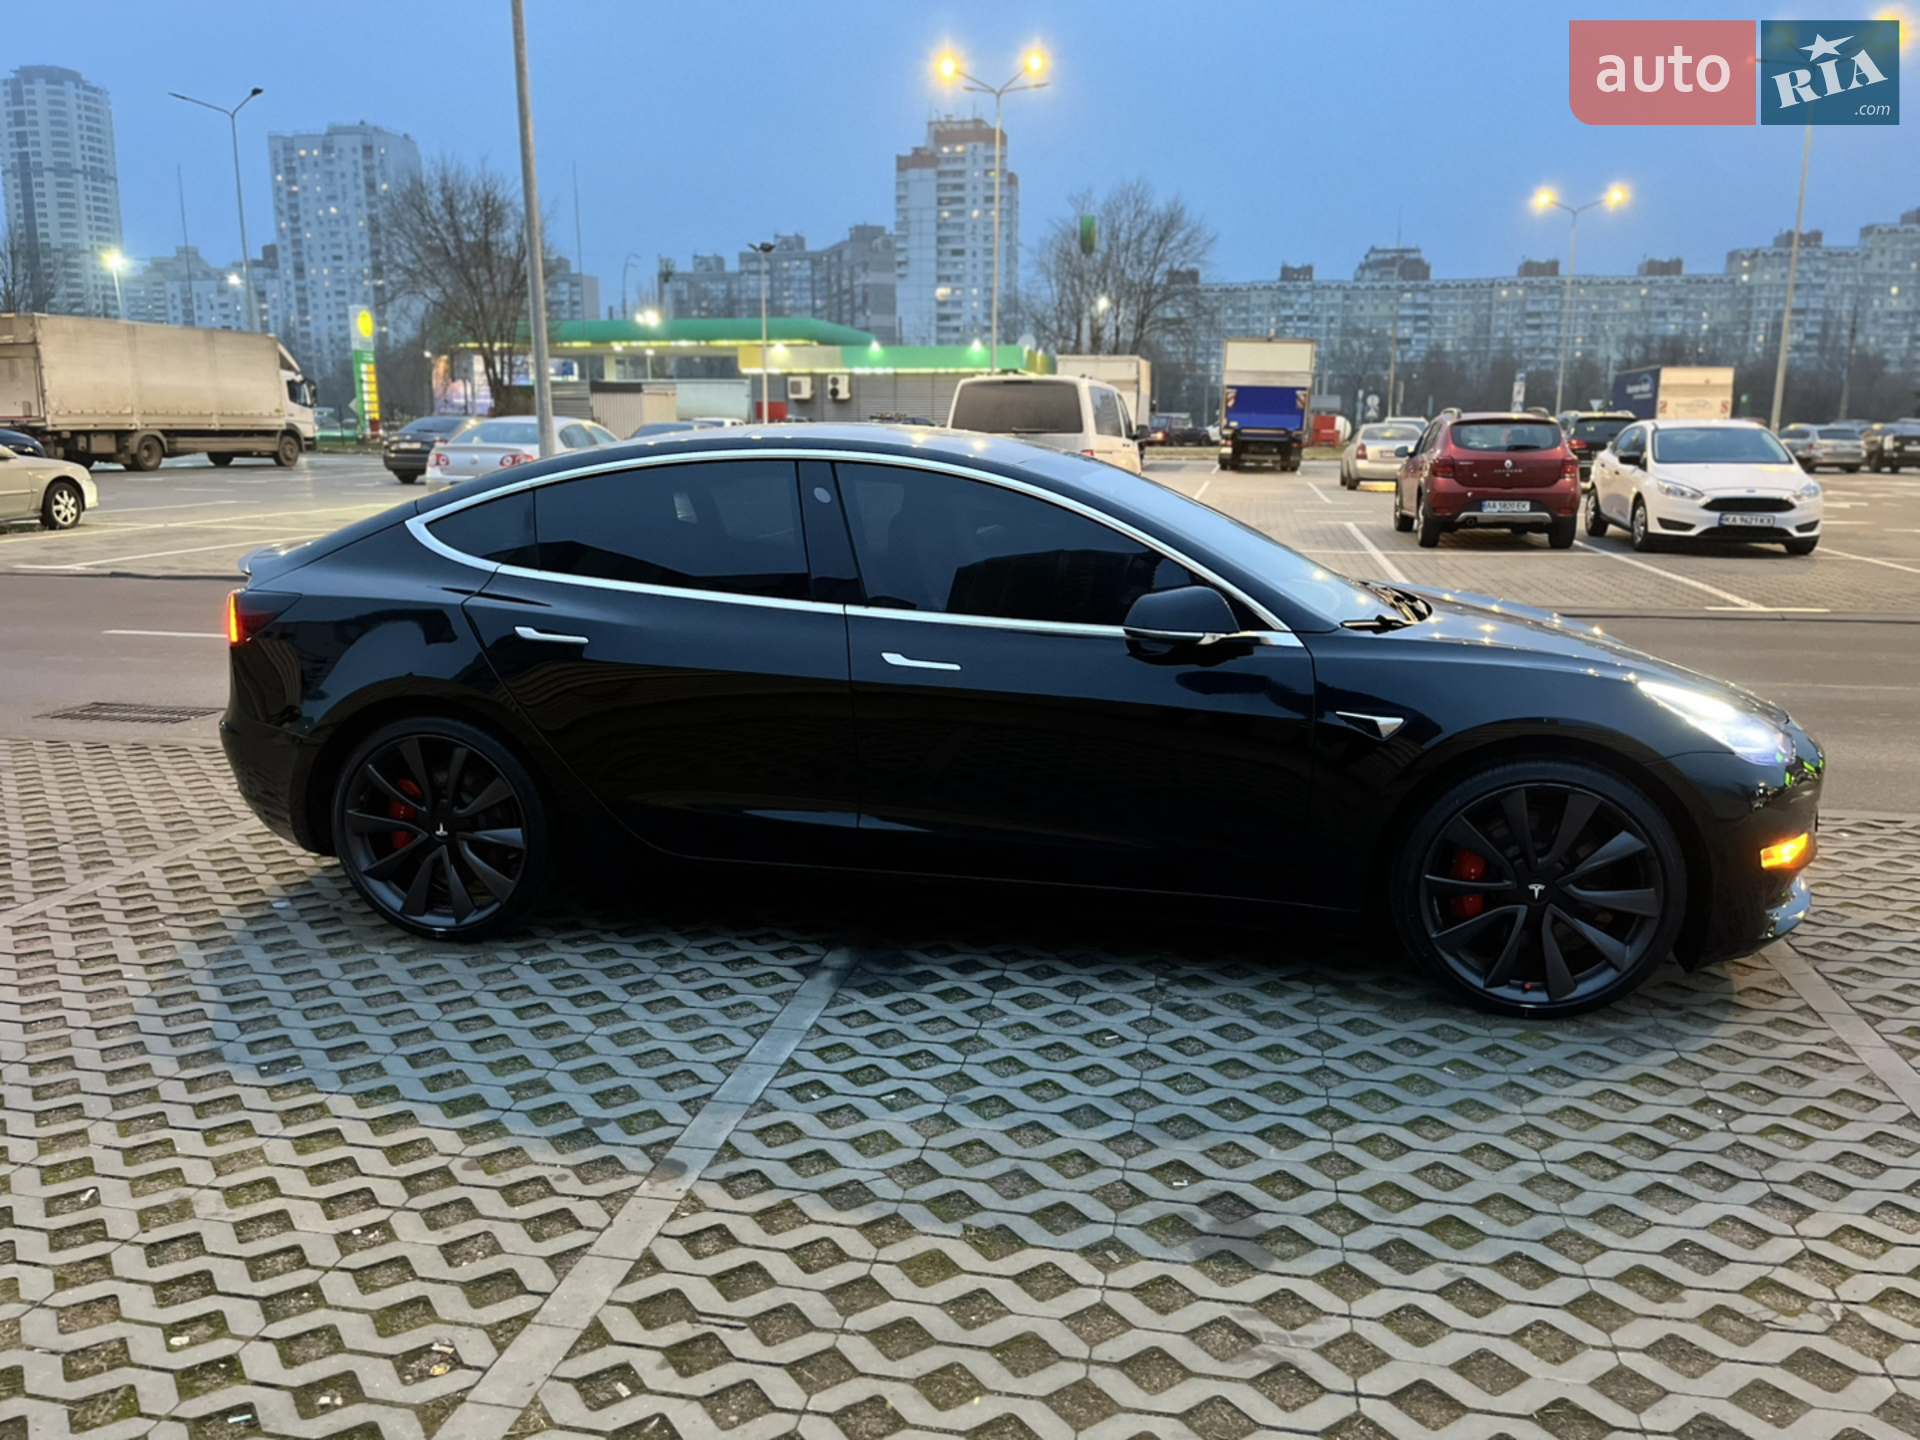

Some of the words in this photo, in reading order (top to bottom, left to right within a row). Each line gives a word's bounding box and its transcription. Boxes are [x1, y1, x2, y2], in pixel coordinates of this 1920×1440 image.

[1487, 502, 1497, 510] AA
[1725, 516, 1737, 524] KA
[1740, 517, 1758, 525] 9621
